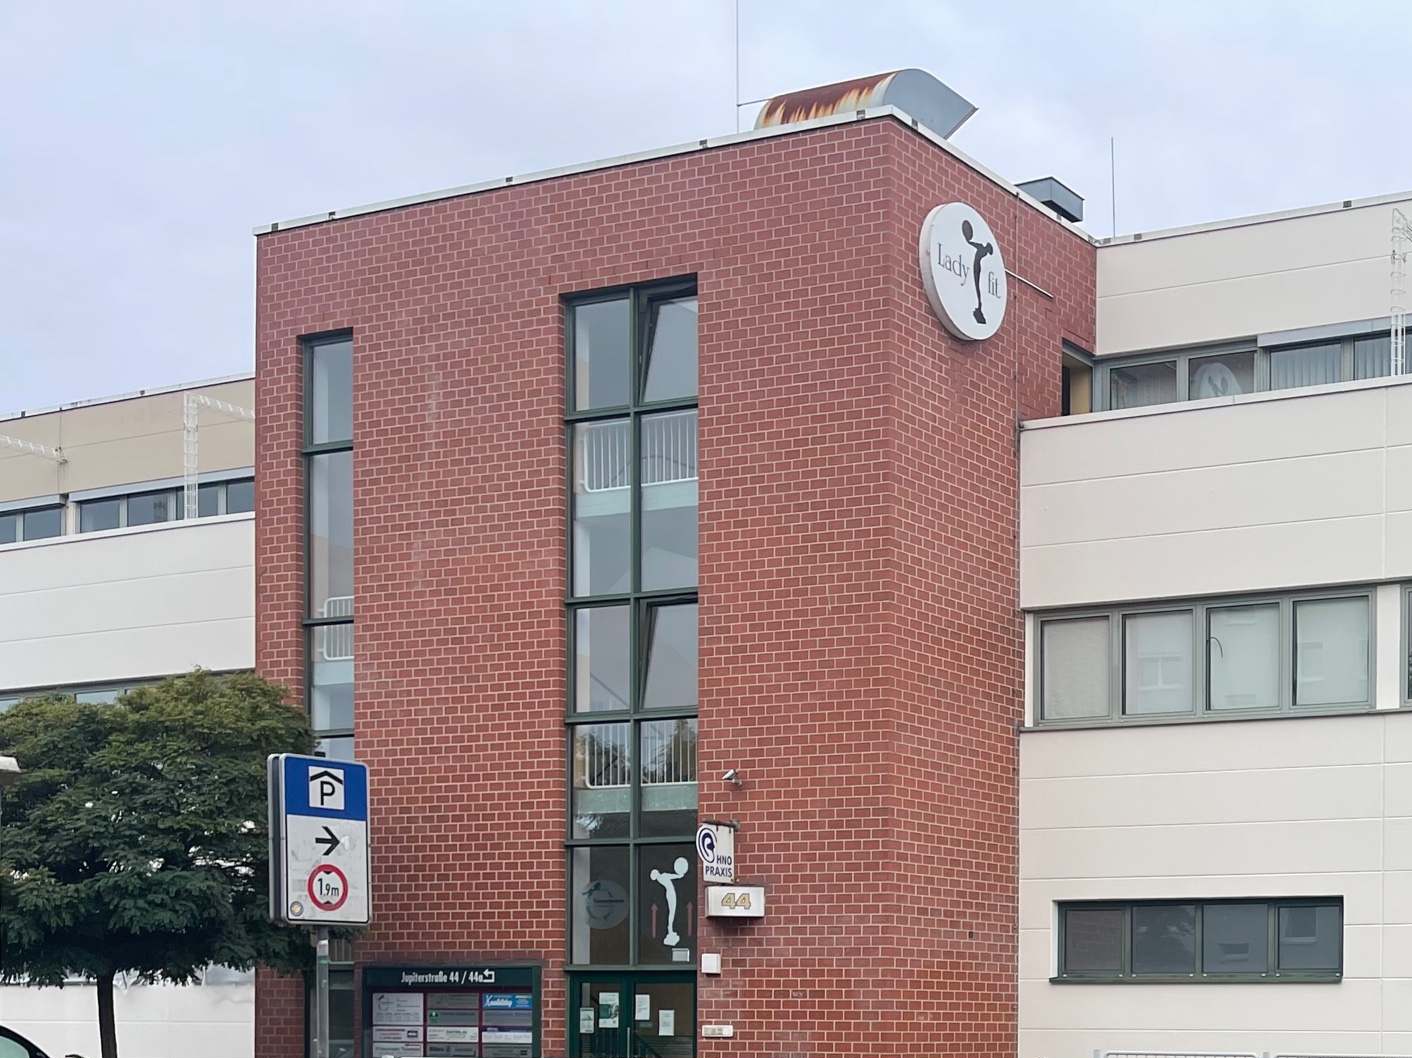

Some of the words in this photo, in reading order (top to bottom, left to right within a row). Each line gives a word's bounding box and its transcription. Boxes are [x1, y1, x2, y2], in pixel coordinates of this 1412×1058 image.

[937, 242, 970, 287] Lady
[987, 271, 1002, 299] fit
[320, 780, 335, 805] P
[716, 855, 732, 866] HNO
[705, 865, 733, 878] PRAXIS
[721, 892, 751, 910] 44
[401, 970, 448, 986] Jupiterstraße
[449, 971, 460, 983] 44
[461, 970, 468, 986] /
